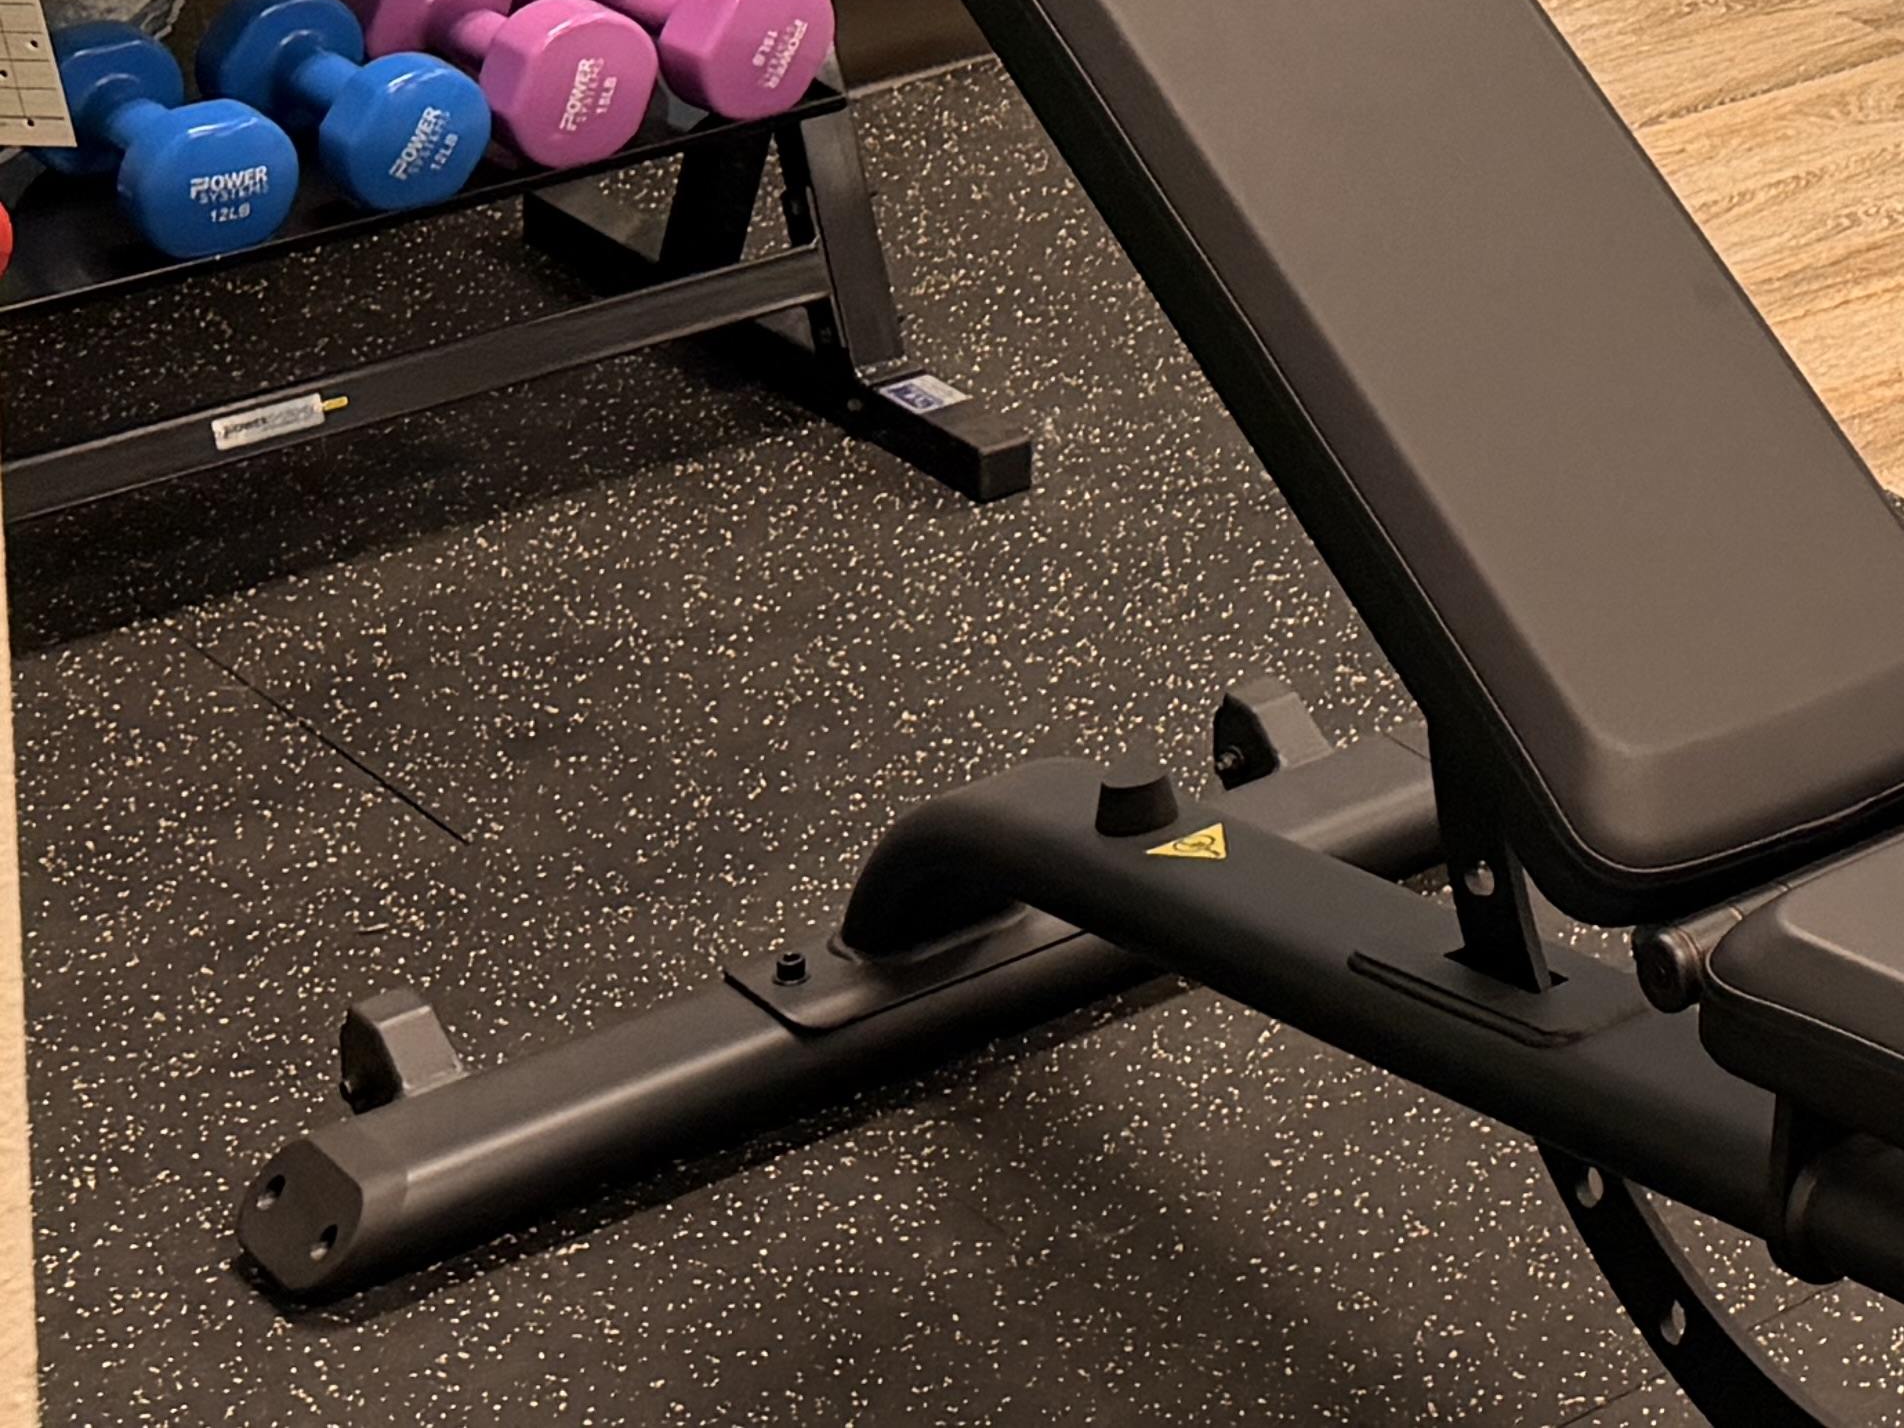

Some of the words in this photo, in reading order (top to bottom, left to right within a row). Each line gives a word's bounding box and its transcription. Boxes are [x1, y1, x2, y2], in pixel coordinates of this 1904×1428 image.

[763, 18, 809, 90] POWER
[558, 57, 596, 132] POWER
[388, 105, 443, 181] POWER
[189, 165, 268, 200] POWER
[209, 202, 251, 223] 12LB
